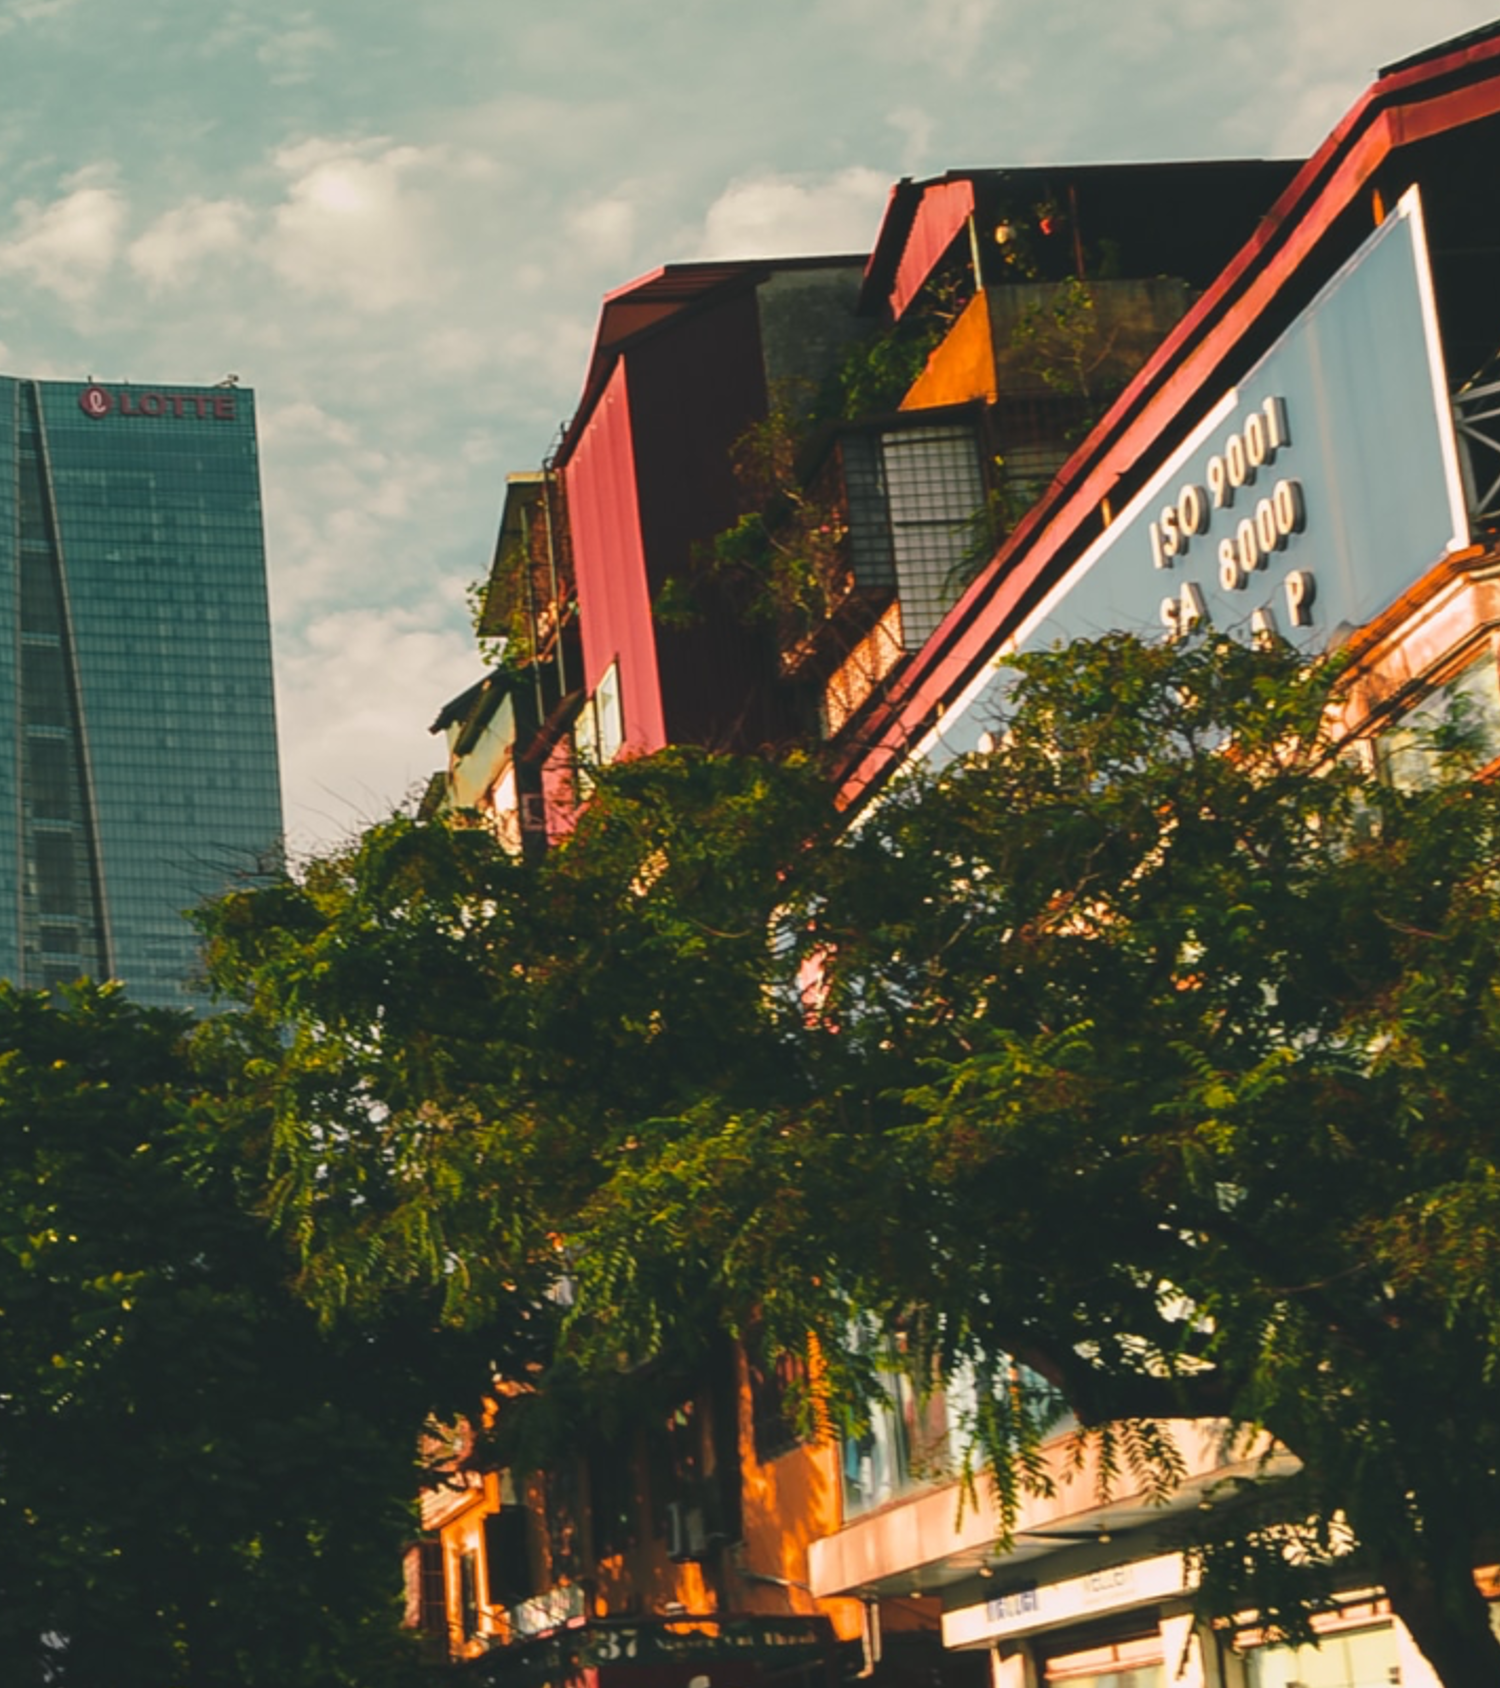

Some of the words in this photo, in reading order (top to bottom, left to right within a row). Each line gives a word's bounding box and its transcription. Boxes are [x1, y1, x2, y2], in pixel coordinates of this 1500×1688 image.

[119, 391, 237, 420] LOTTE
[1149, 483, 1207, 569] ISO
[1206, 395, 1291, 509] 9001
[1160, 581, 1209, 646] SA
[1217, 478, 1306, 591] 8000
[598, 1628, 638, 1660] 37
